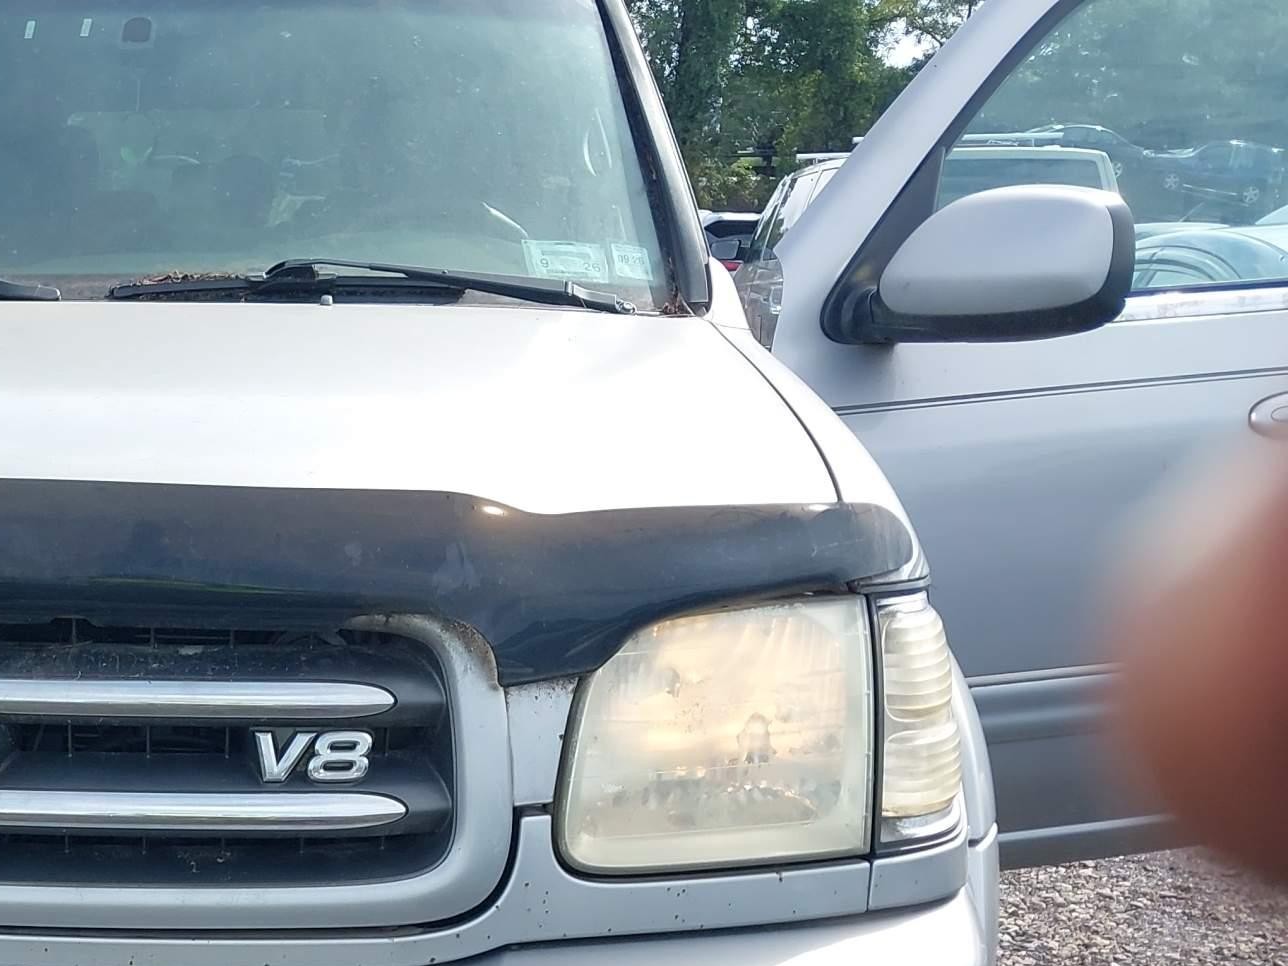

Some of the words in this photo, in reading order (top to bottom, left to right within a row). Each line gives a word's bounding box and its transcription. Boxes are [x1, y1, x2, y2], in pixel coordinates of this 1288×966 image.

[540, 257, 549, 268] 9
[583, 262, 601, 273] 26
[254, 730, 373, 782] V8
